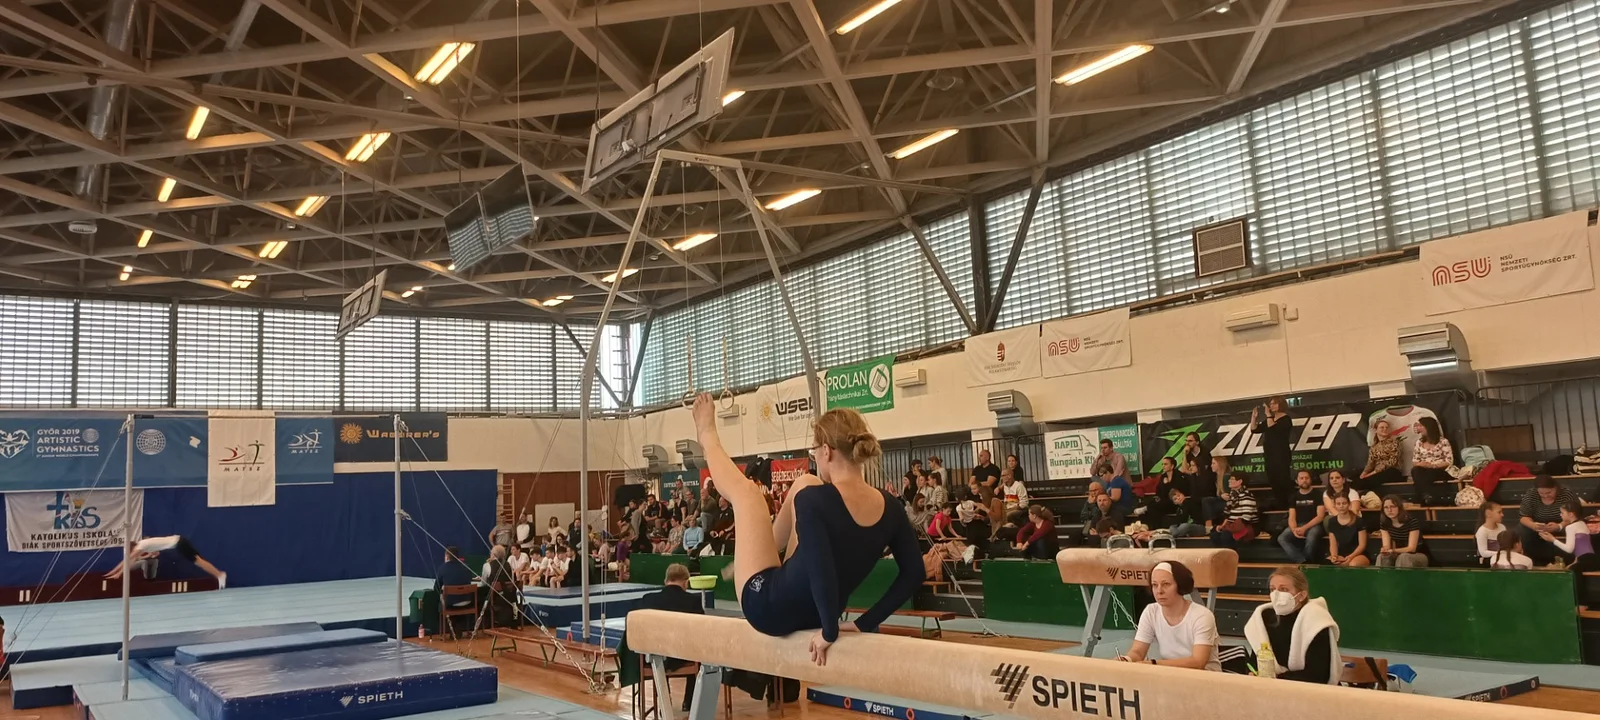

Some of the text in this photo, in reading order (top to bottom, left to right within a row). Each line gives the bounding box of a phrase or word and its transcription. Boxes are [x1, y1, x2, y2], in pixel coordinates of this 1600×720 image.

[1500, 258, 1529, 267] NEMZETI
[826, 370, 868, 391] PROLAN
[62, 428, 80, 436] 2019
[36, 436, 81, 444] ARTISTIC
[1054, 440, 1079, 450] RAPID
[36, 445, 100, 454] GYMNASTICS
[1049, 457, 1083, 468] Hungária
[30, 533, 79, 541] KATOLIKUS
[1120, 569, 1150, 581] SPIET
[357, 690, 404, 705] SPIETH
[1032, 675, 1142, 720] SPIETH
[872, 703, 894, 716] SPIETH
